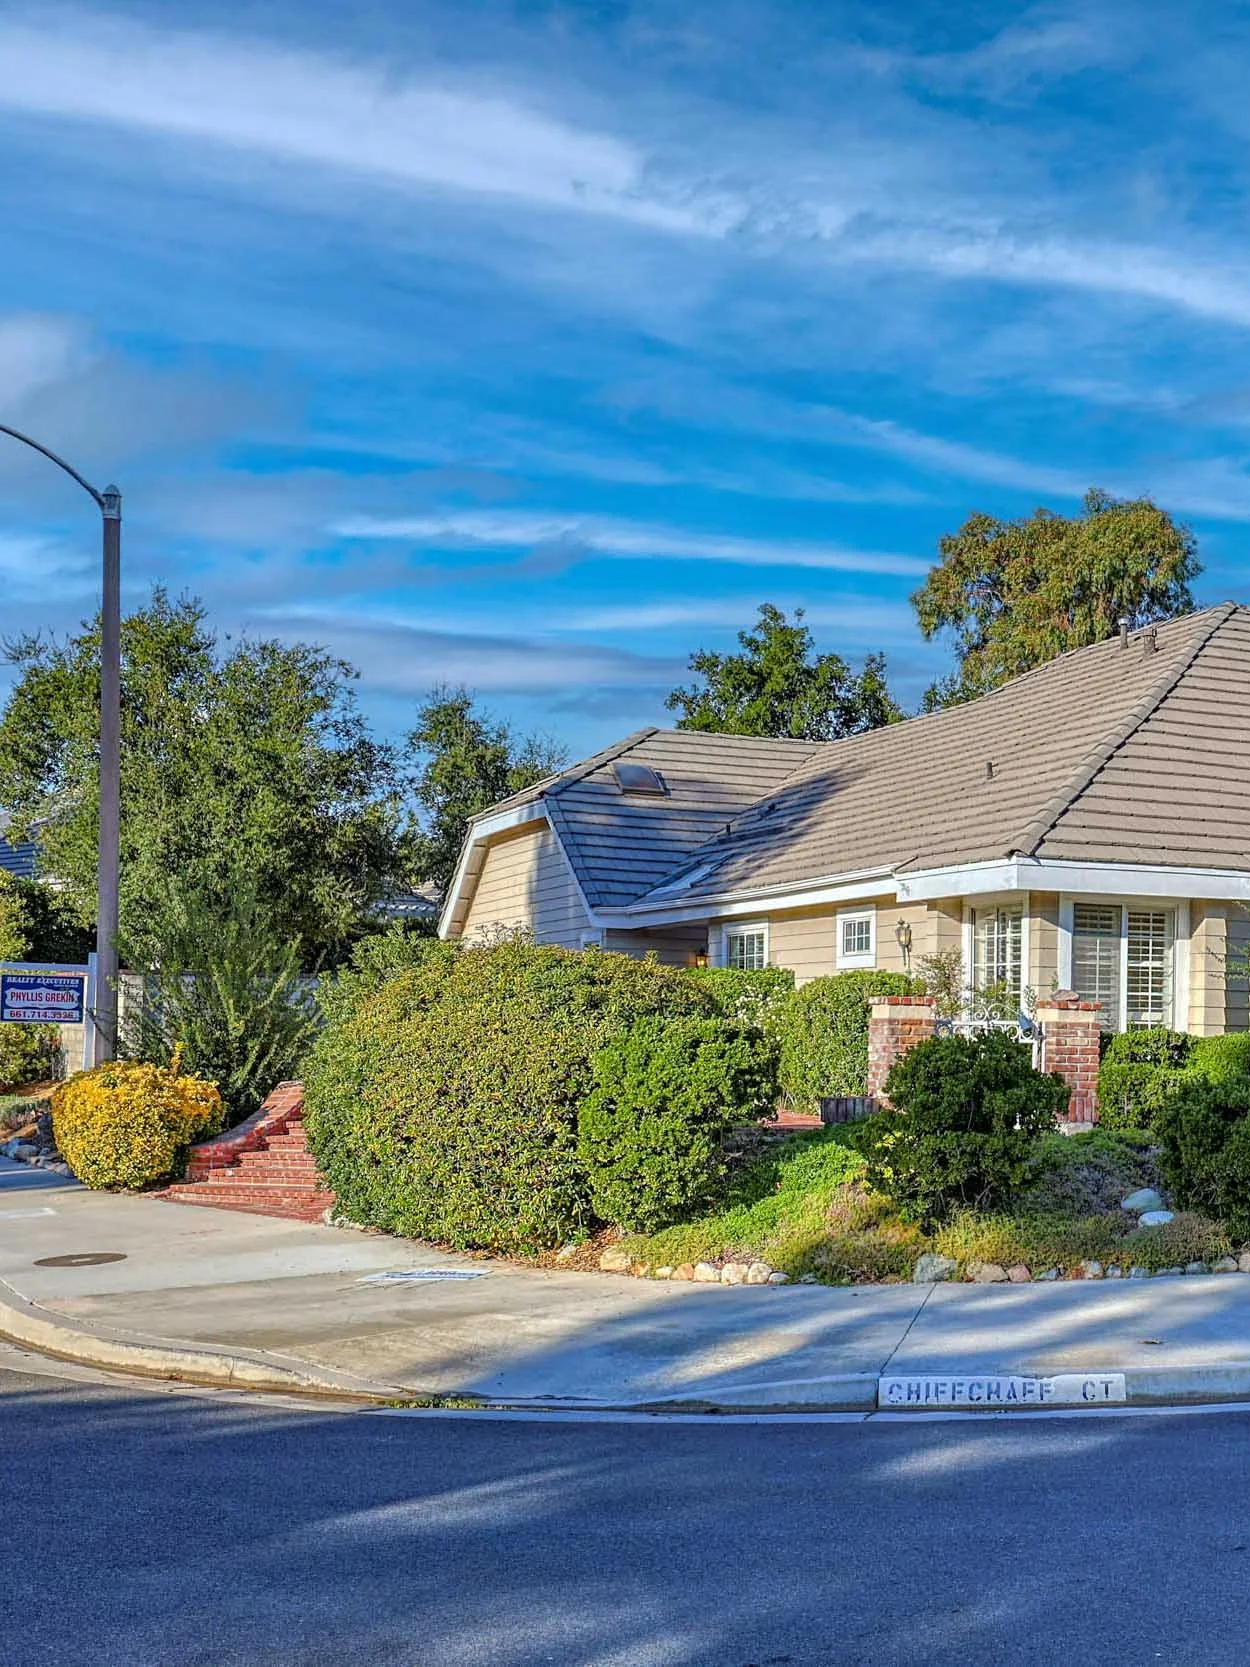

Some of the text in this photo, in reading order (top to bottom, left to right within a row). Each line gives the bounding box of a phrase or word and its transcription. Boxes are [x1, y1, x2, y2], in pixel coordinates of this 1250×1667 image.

[11, 991, 43, 1002] PHYLLIS
[888, 1379, 1114, 1403] CHIFFCHAFF CT
